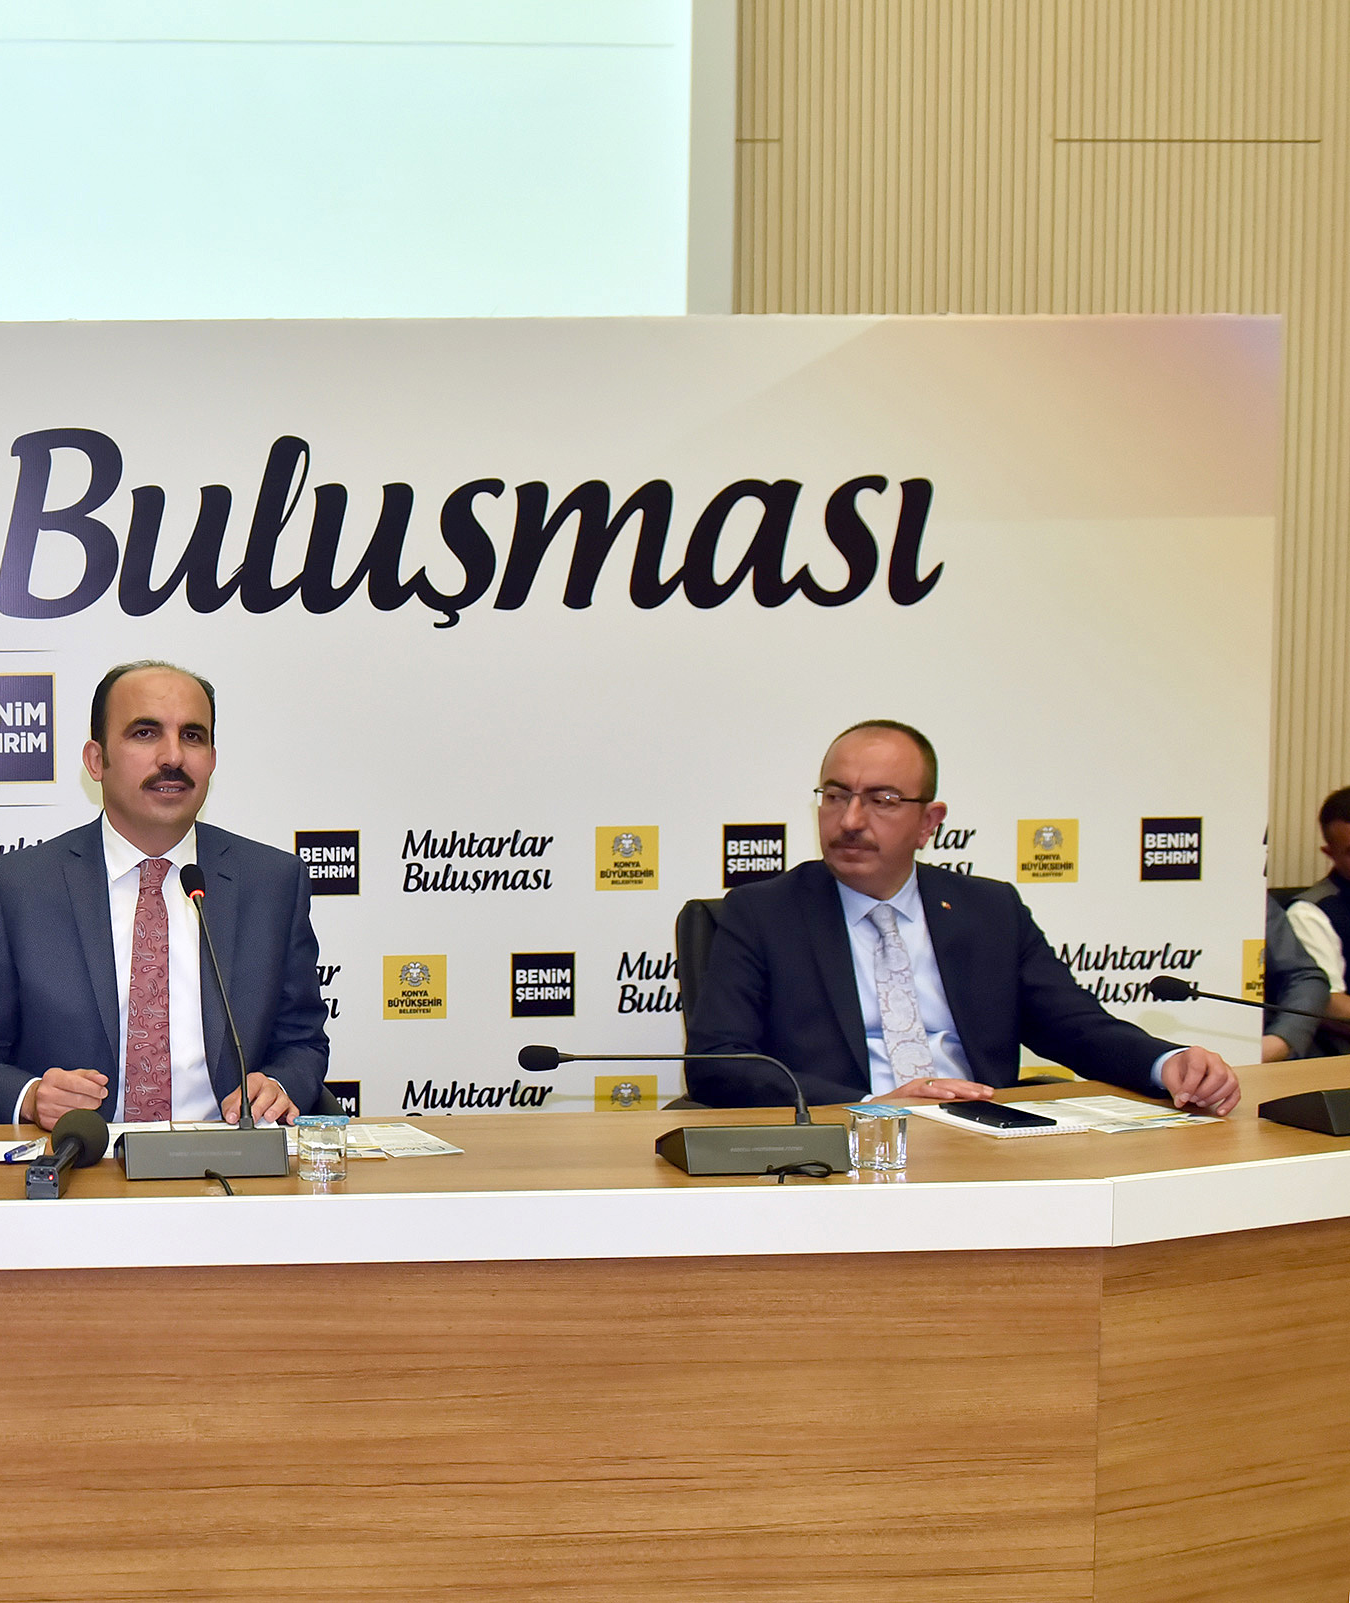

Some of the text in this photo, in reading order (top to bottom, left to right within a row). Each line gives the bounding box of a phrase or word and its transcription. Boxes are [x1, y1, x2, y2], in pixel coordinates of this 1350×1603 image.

[401, 829, 554, 860] Muhtarlar
[402, 862, 553, 894] Buluşması
[1060, 942, 1202, 971] Muhtarlar
[387, 997, 443, 1008] BÜYÜKŞEHİR
[402, 1079, 553, 1110] Muhtarlar
